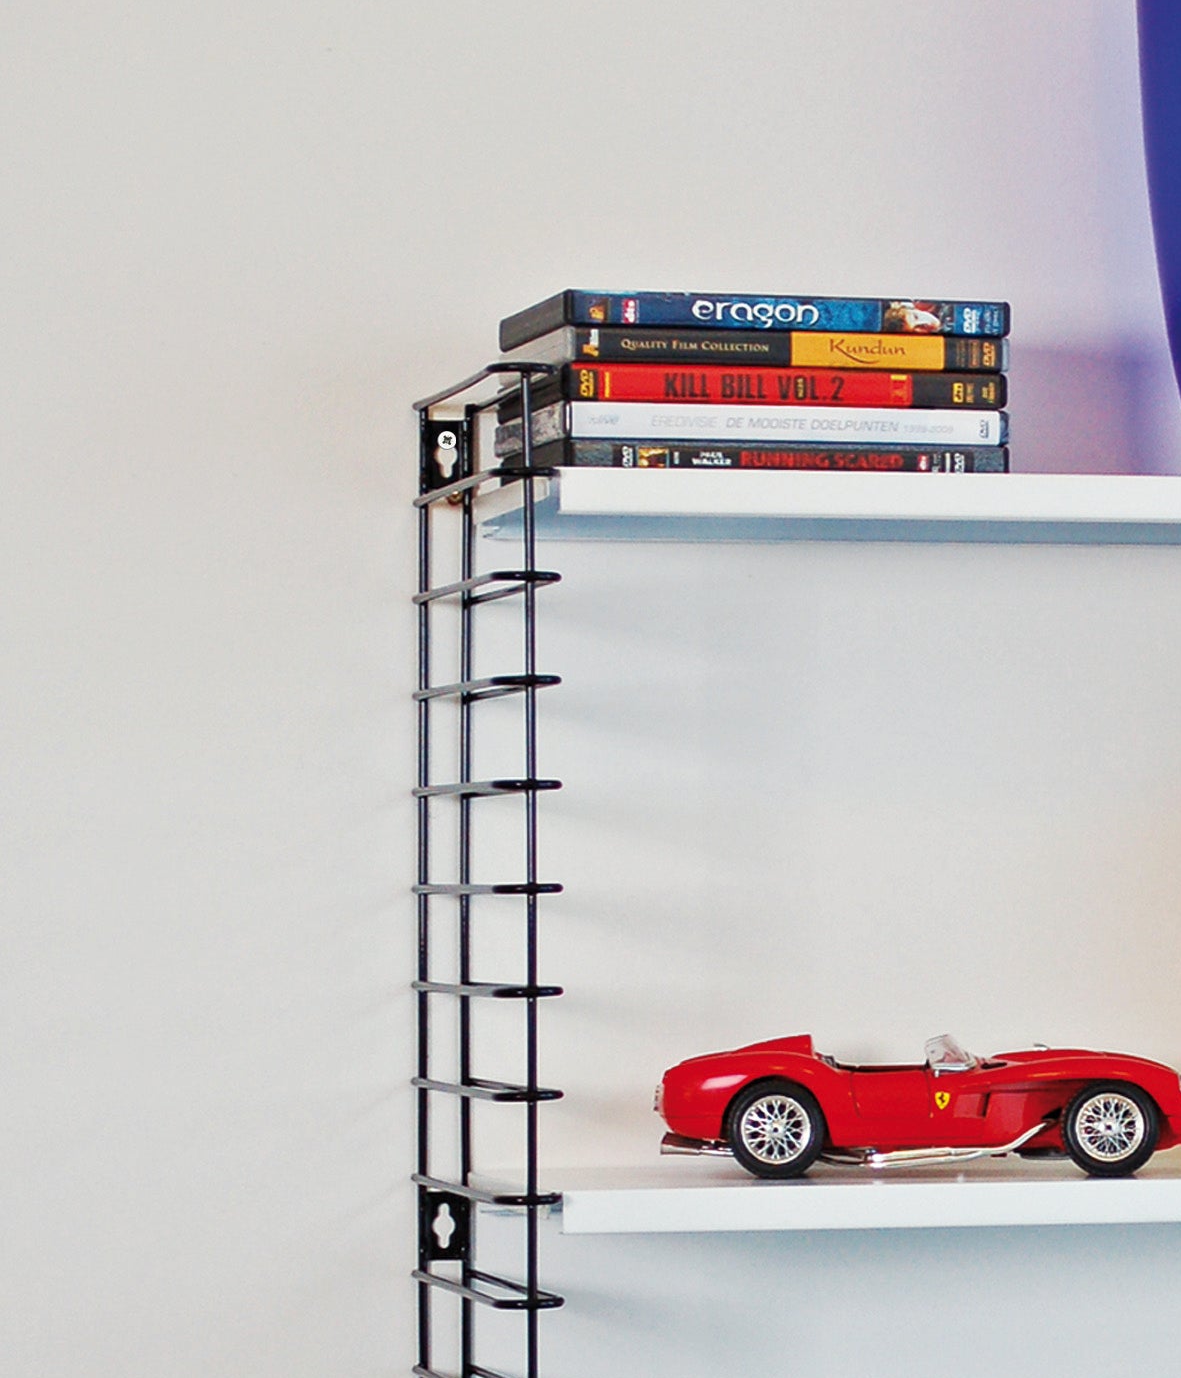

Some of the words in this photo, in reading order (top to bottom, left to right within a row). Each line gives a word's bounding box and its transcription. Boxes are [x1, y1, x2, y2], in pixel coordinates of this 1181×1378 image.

[691, 299, 820, 329] eragon
[672, 339, 699, 351] FILM
[701, 340, 770, 353] COLLECTION
[829, 338, 906, 364] Kundun
[664, 373, 711, 398] KILL
[721, 373, 767, 399] BILL
[725, 418, 745, 428] DE
[748, 418, 806, 430] MOOISTE
[810, 419, 899, 432] DOELPUNTEN
[739, 450, 830, 466] RUNNING
[833, 451, 904, 468] SCARED
